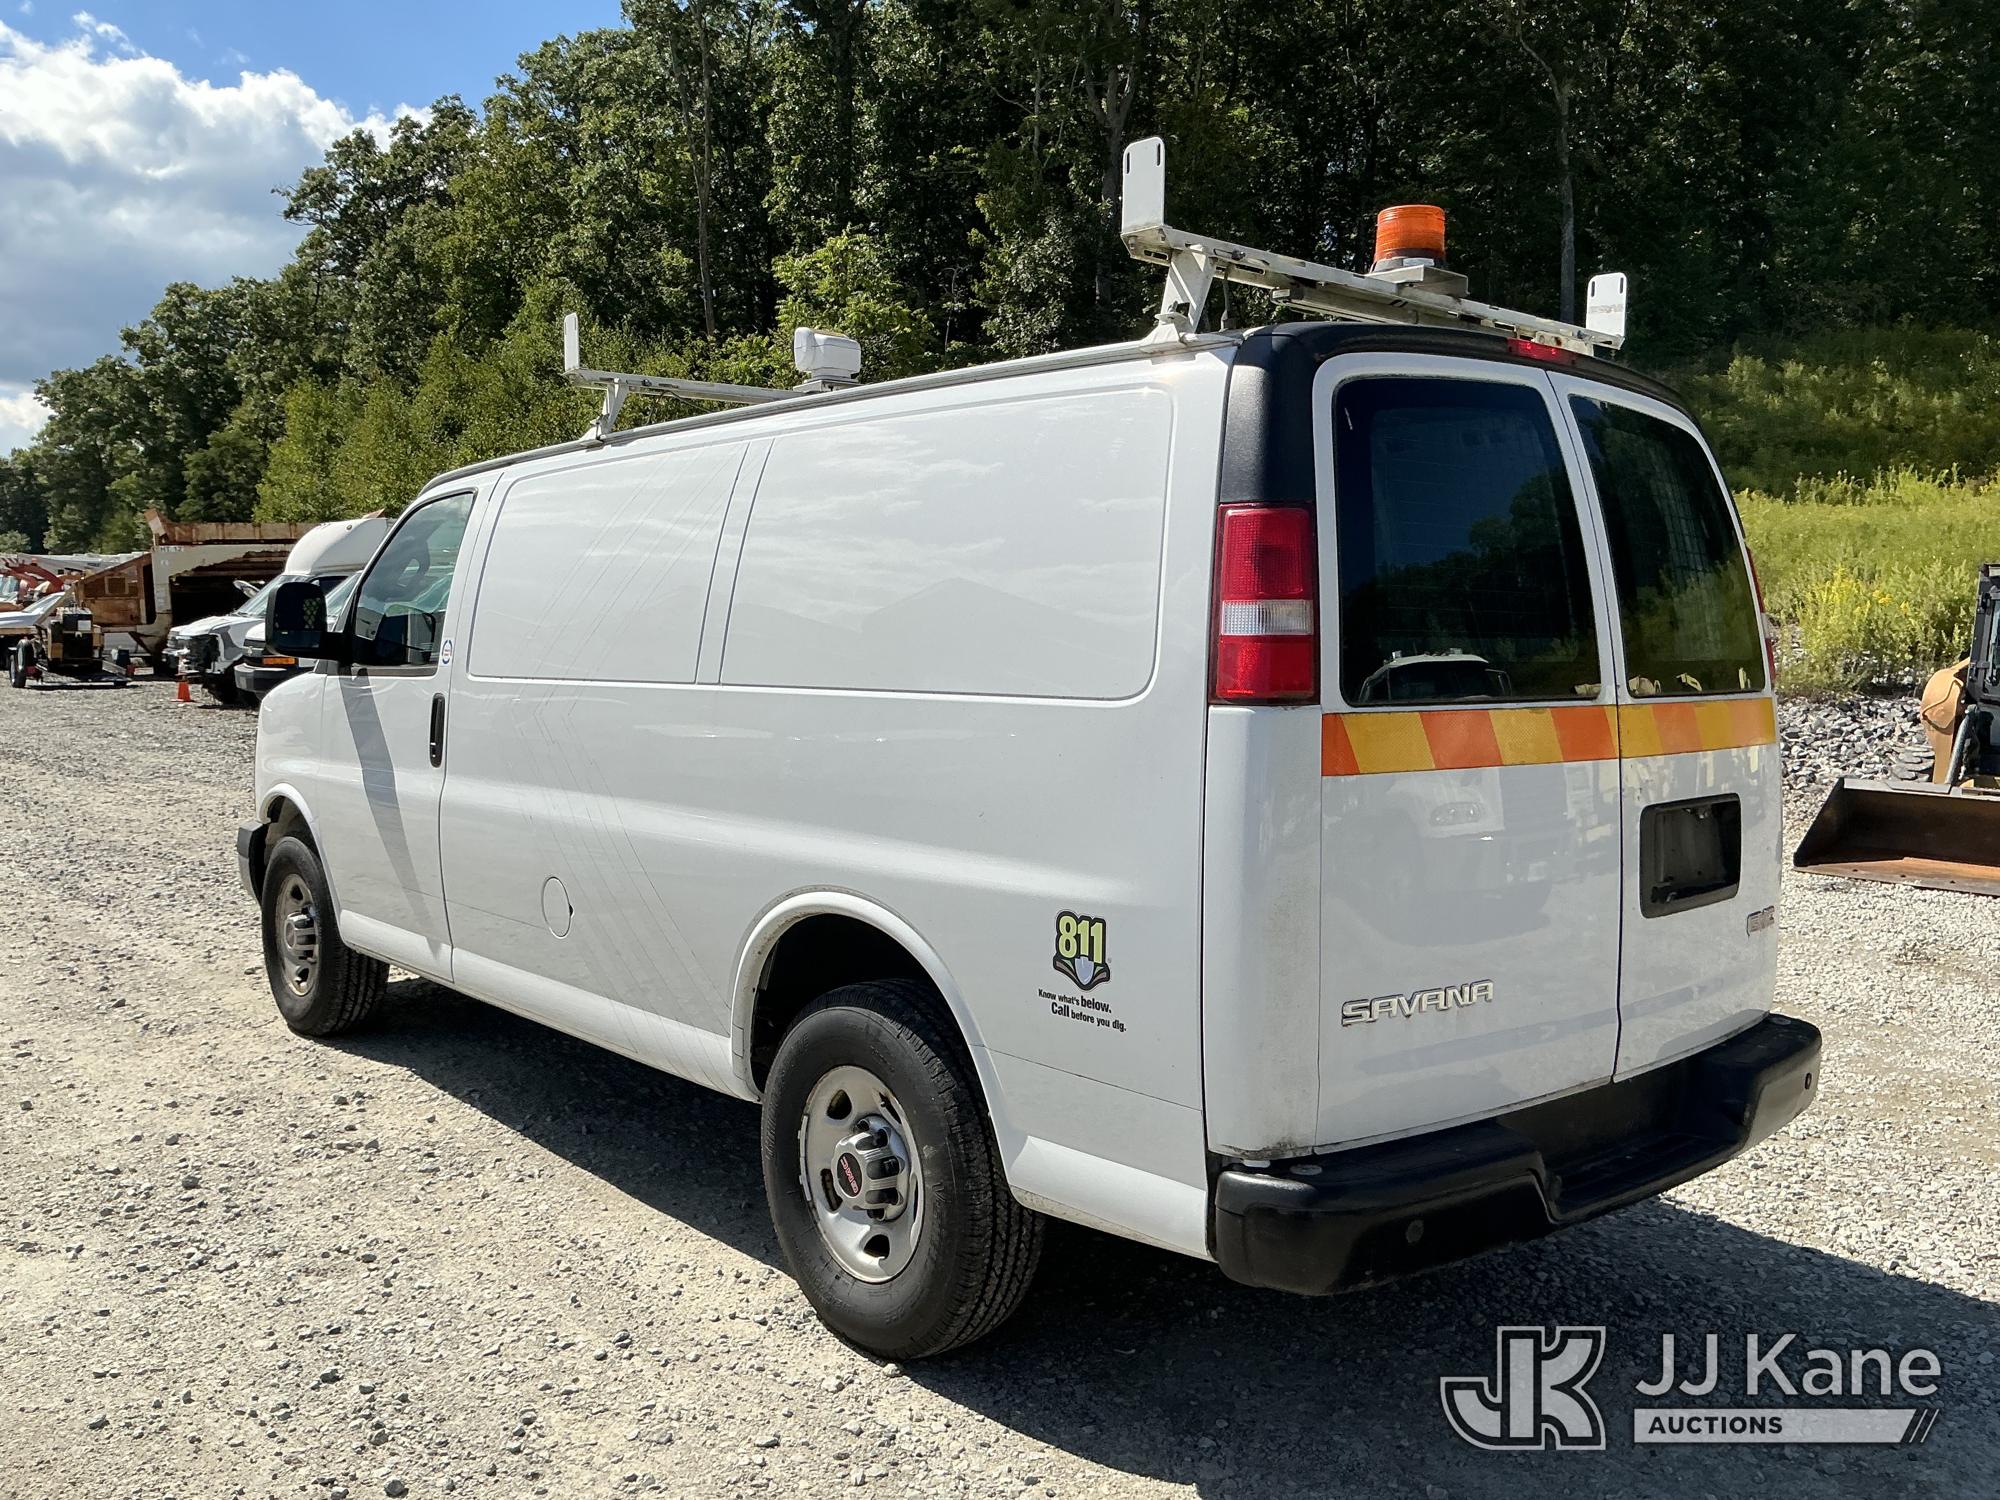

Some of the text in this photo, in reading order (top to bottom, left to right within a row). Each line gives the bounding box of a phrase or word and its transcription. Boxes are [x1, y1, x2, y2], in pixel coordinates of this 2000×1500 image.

[1057, 914, 1104, 964] 811
[1038, 988, 1112, 1013] Know what's below.
[1051, 1001, 1127, 1032] Call before you dig.
[1341, 979, 1494, 1027] SAVANA
[840, 1156, 859, 1194] GMC
